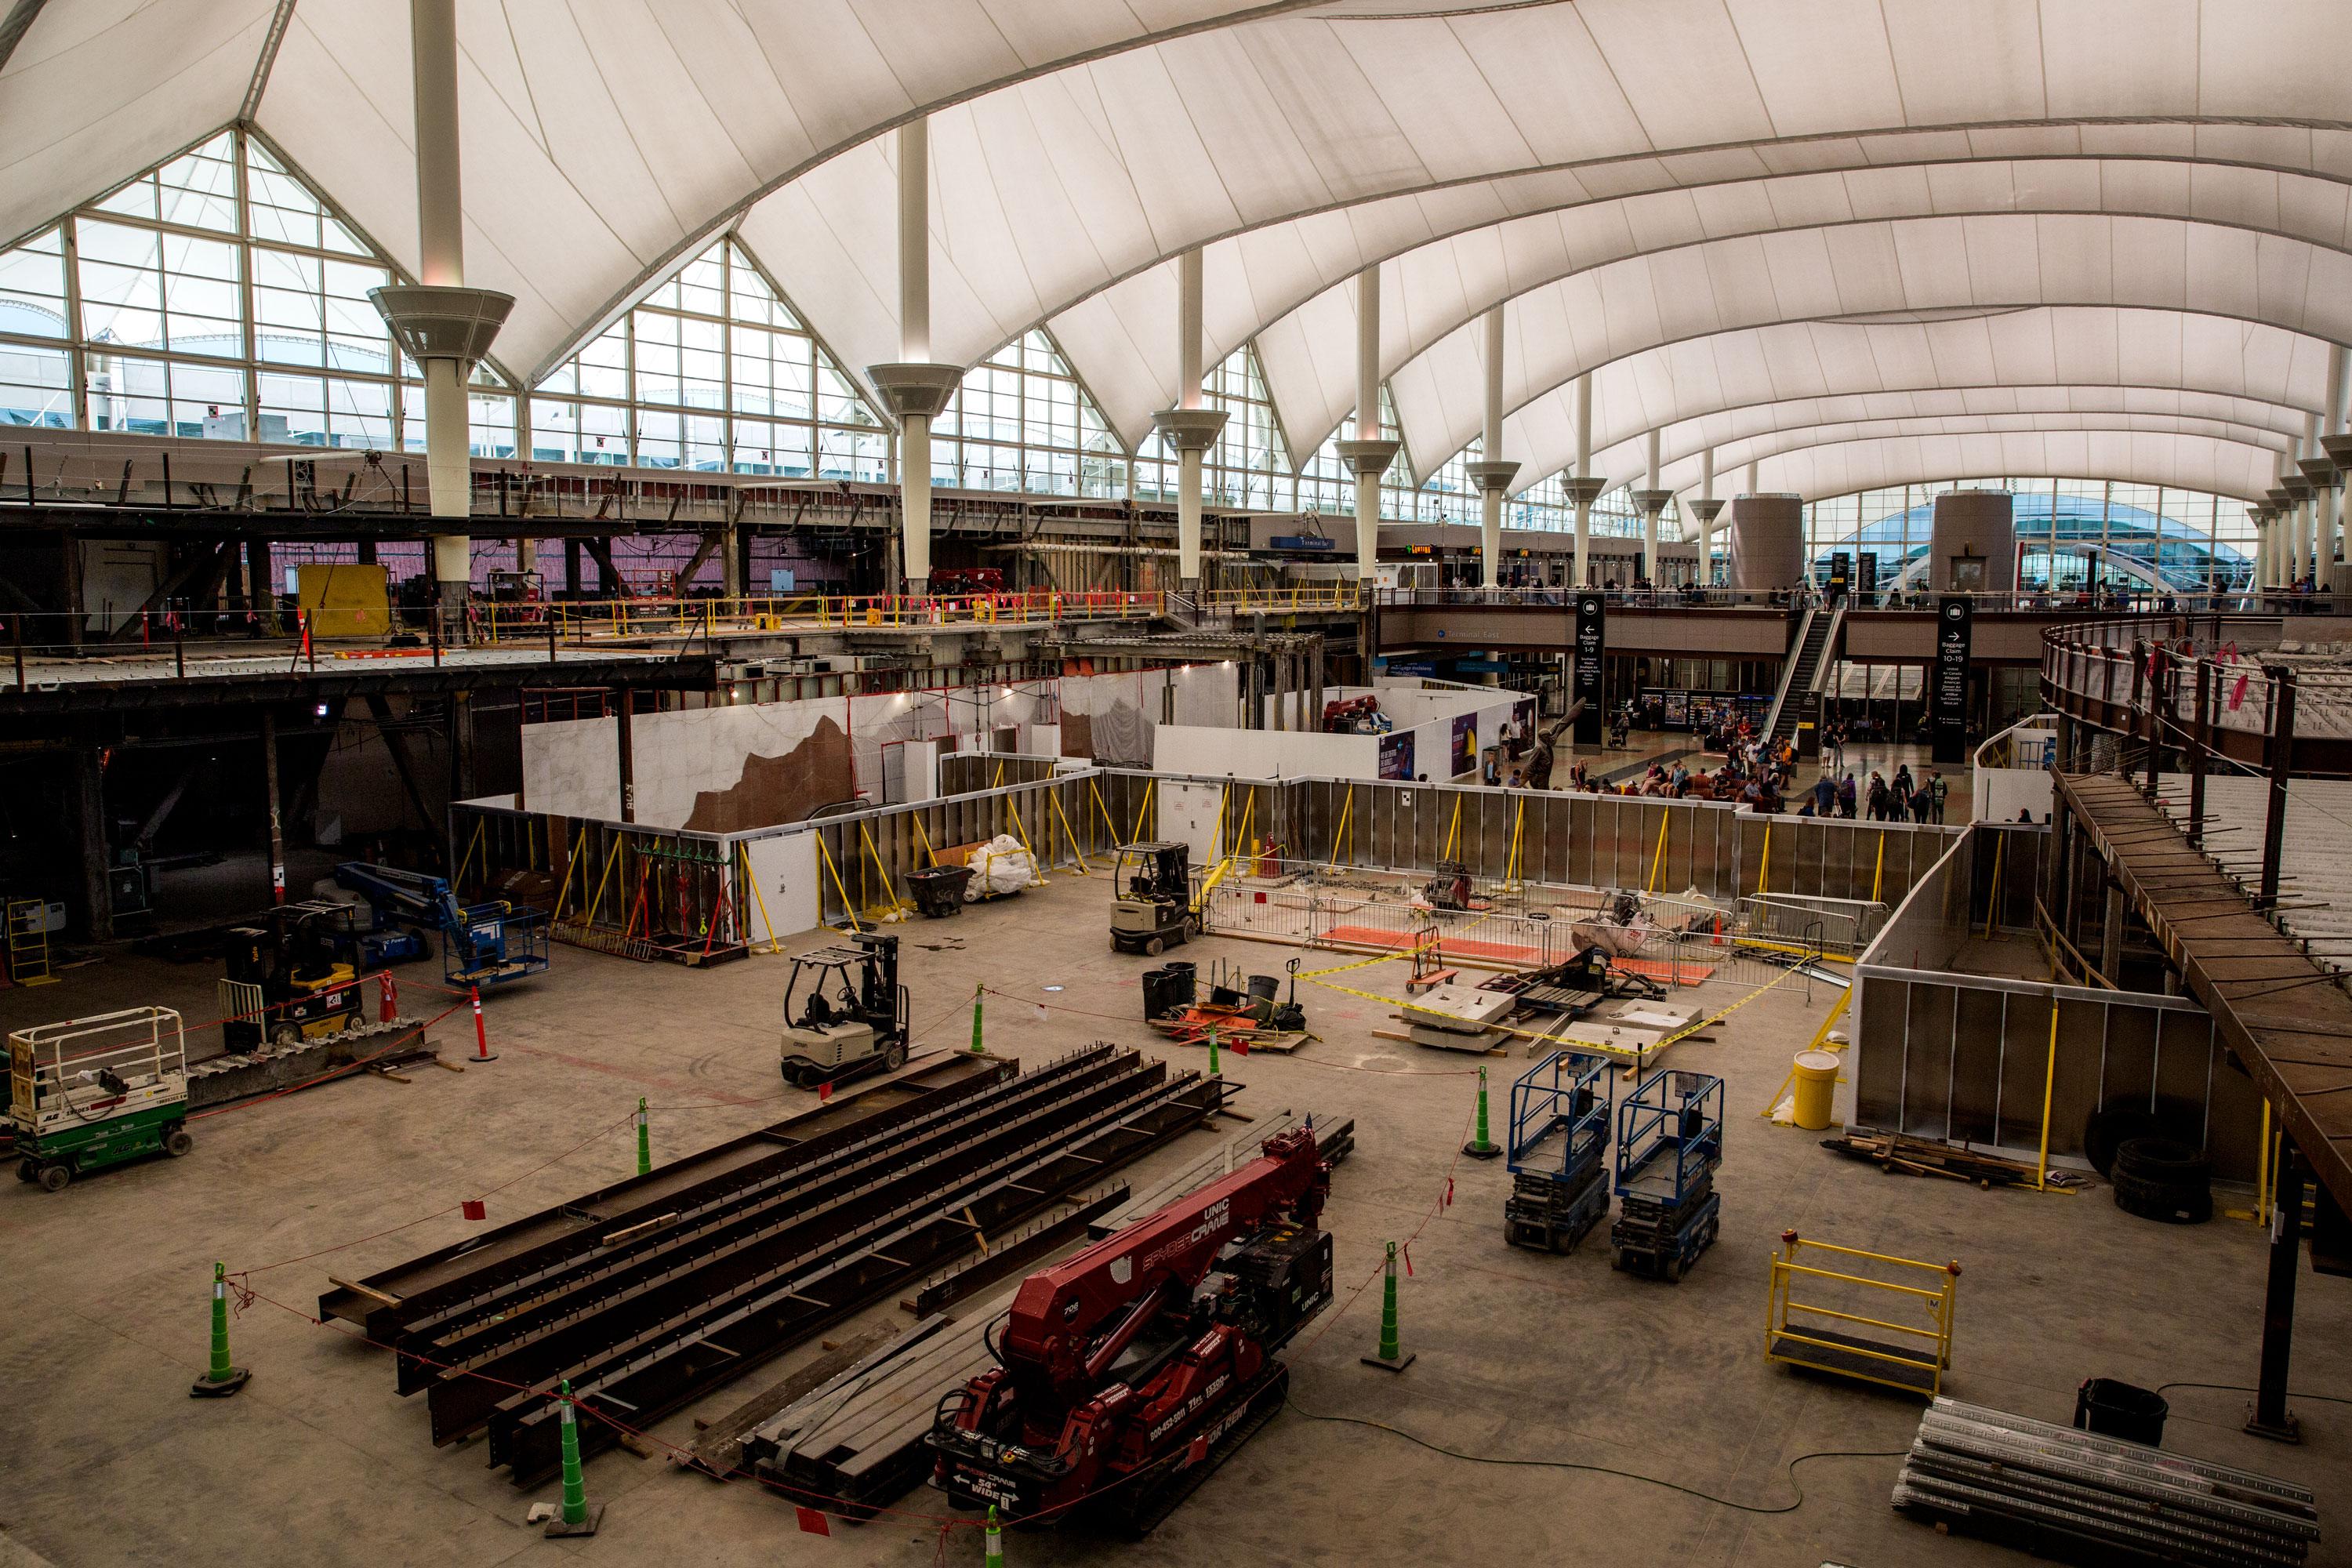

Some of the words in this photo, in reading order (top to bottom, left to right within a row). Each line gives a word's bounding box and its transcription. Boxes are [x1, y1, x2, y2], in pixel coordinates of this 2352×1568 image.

[43, 1113, 60, 1122] JLG
[1204, 1198, 1229, 1221] UNIC
[1301, 1291, 1319, 1312] UNIC
[1930, 1299, 1939, 1308] M
[1225, 1400, 1248, 1432] RENT
[971, 1483, 1000, 1501] WIDE
[978, 1478, 996, 1490] 54"
